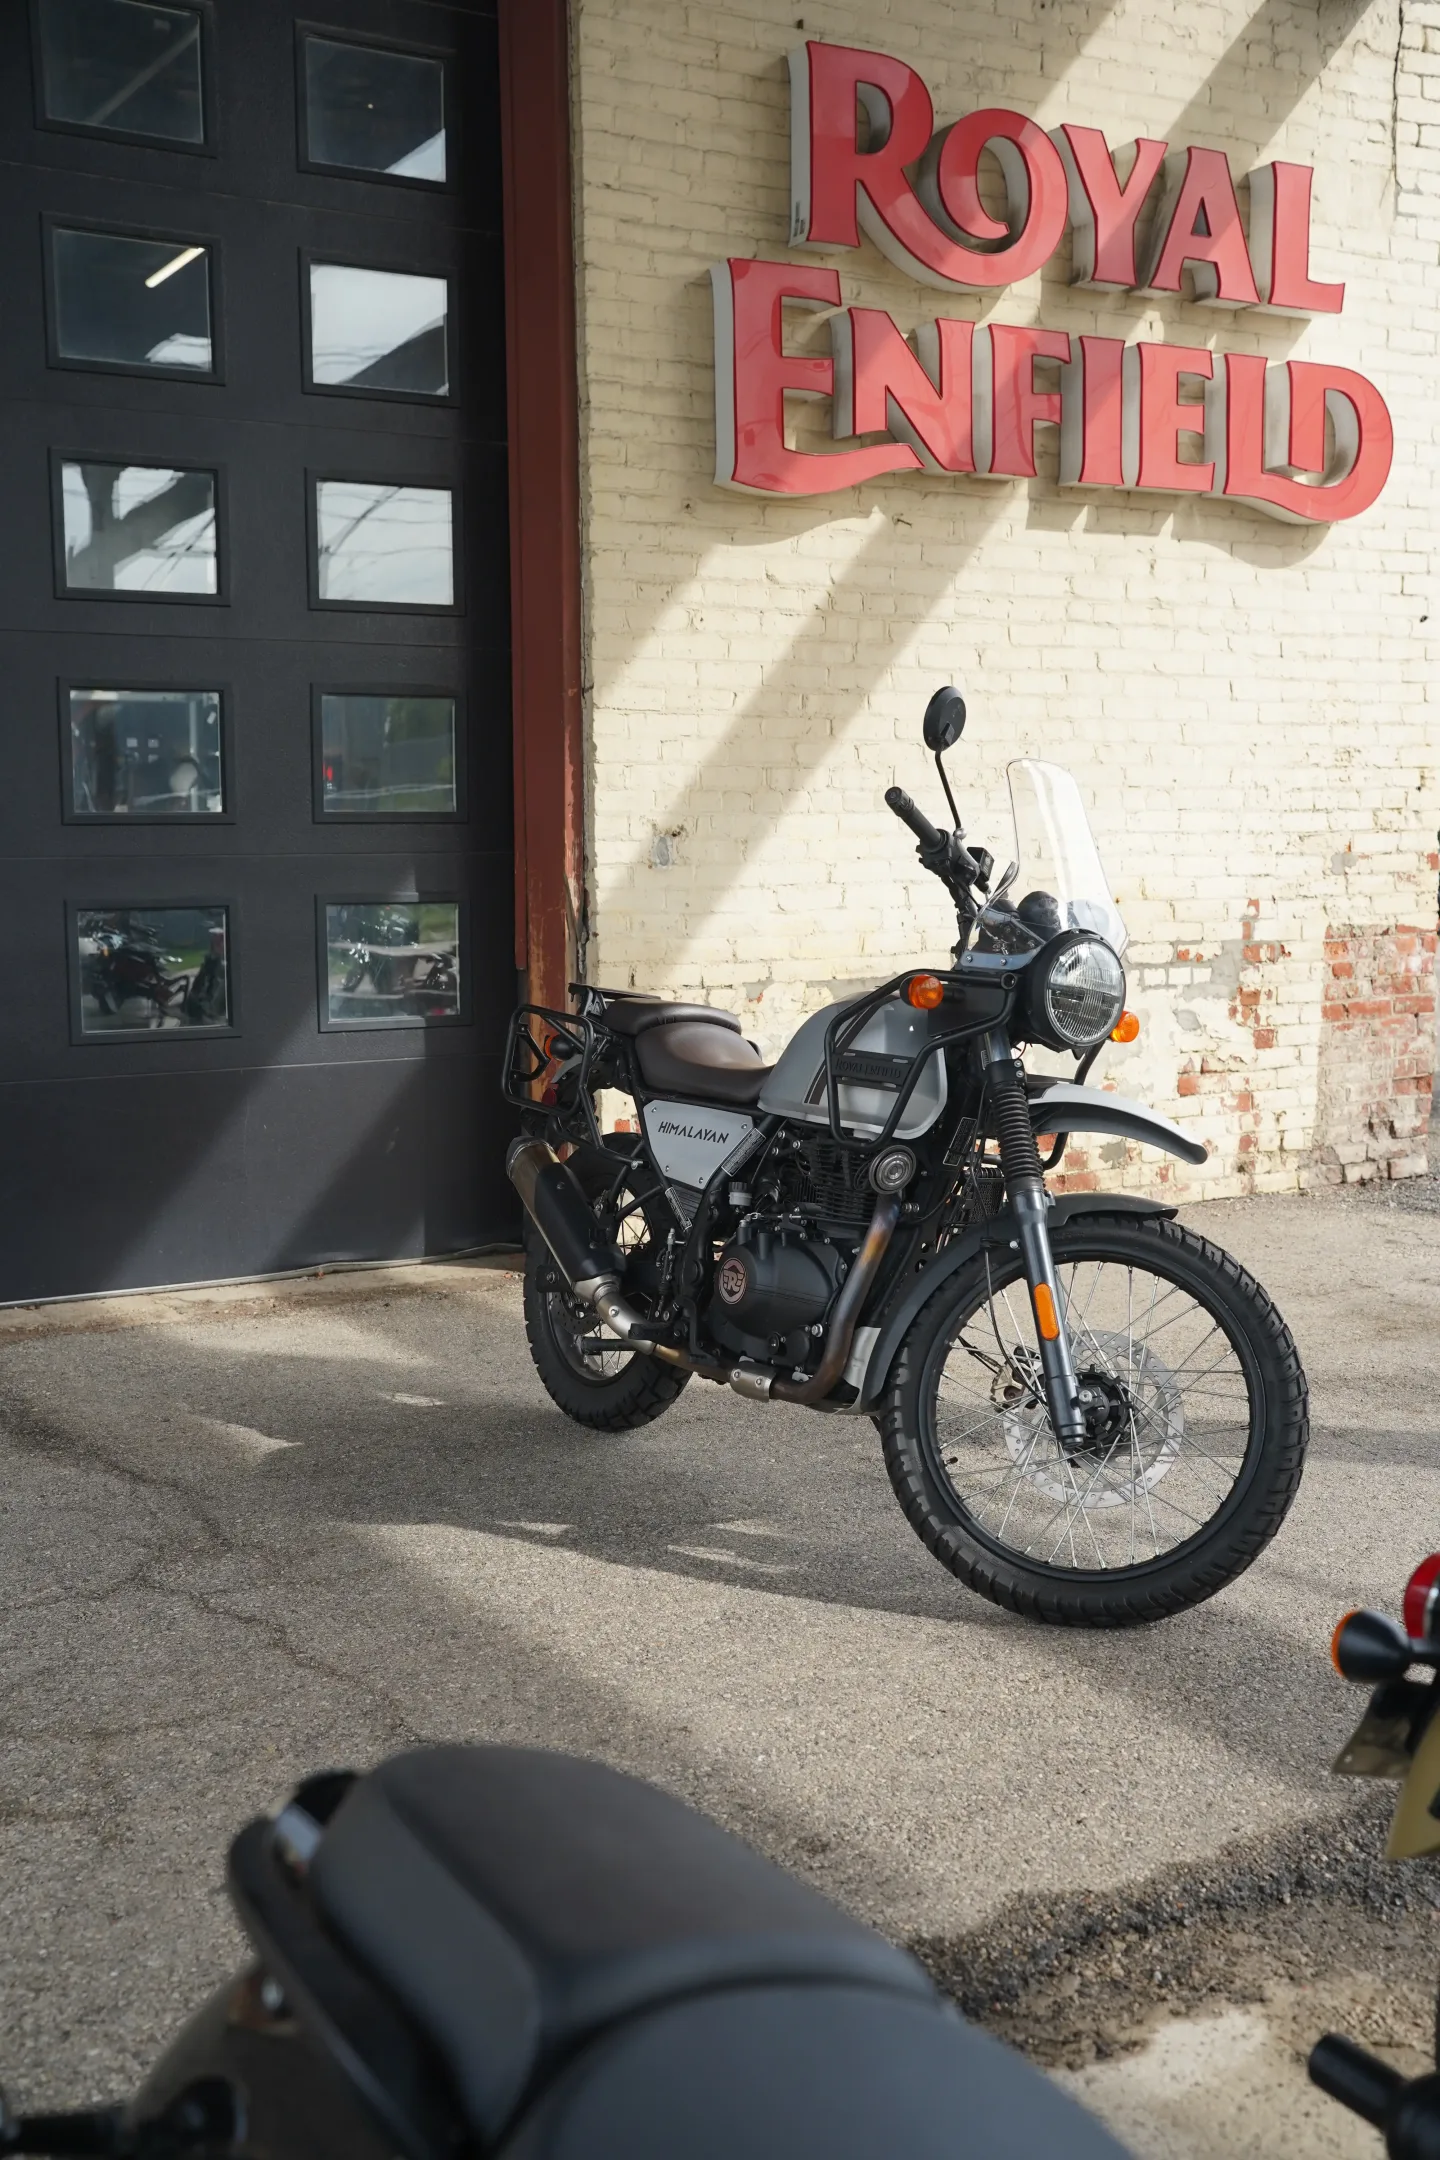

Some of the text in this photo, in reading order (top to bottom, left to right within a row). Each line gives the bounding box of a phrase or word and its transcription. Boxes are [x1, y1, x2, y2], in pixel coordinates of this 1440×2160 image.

[805, 40, 1345, 313] ROYAL
[726, 258, 1394, 523] ENFIELD
[658, 1121, 729, 1144] HIMALAYAN
